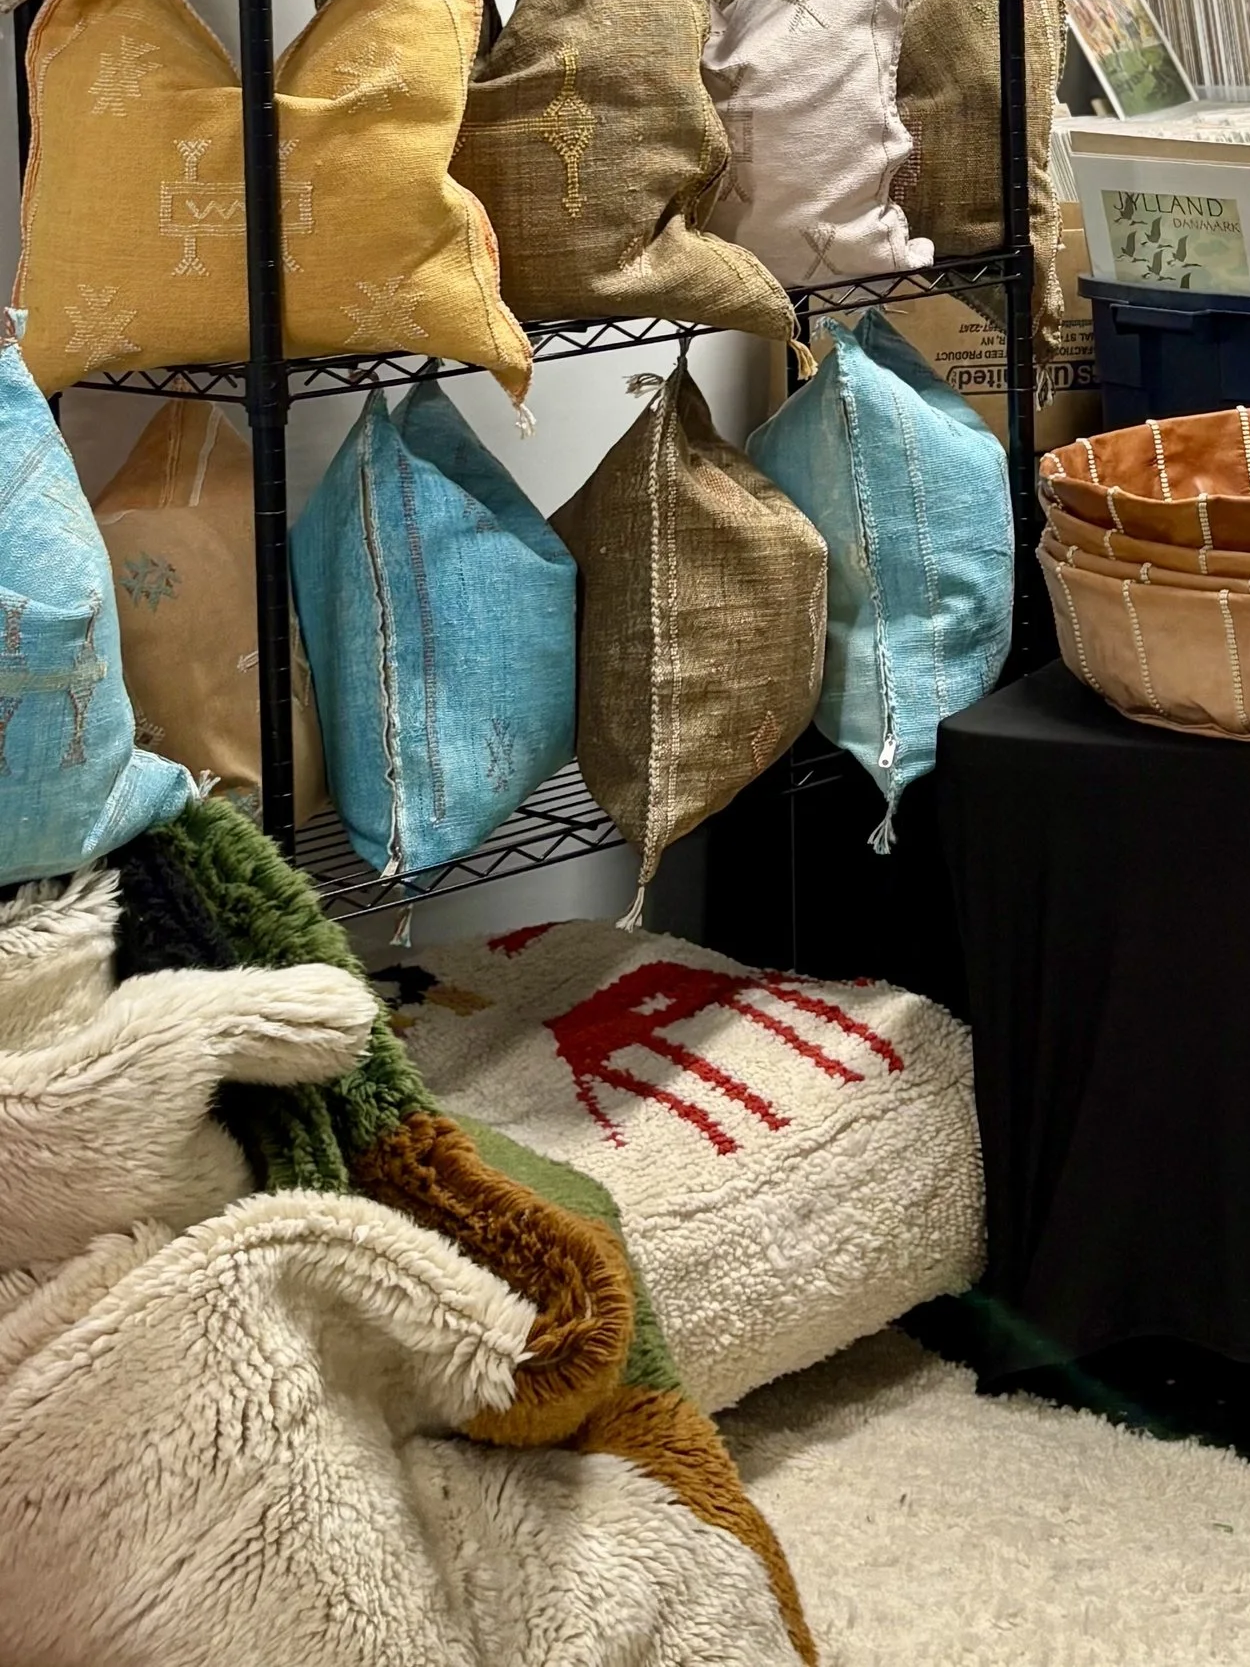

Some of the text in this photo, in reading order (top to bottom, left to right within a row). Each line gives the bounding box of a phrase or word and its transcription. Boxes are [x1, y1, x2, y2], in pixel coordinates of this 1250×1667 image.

[1173, 217, 1241, 233] DANMARK
[980, 336, 994, 346] NY
[935, 349, 982, 361] PRODUCT
